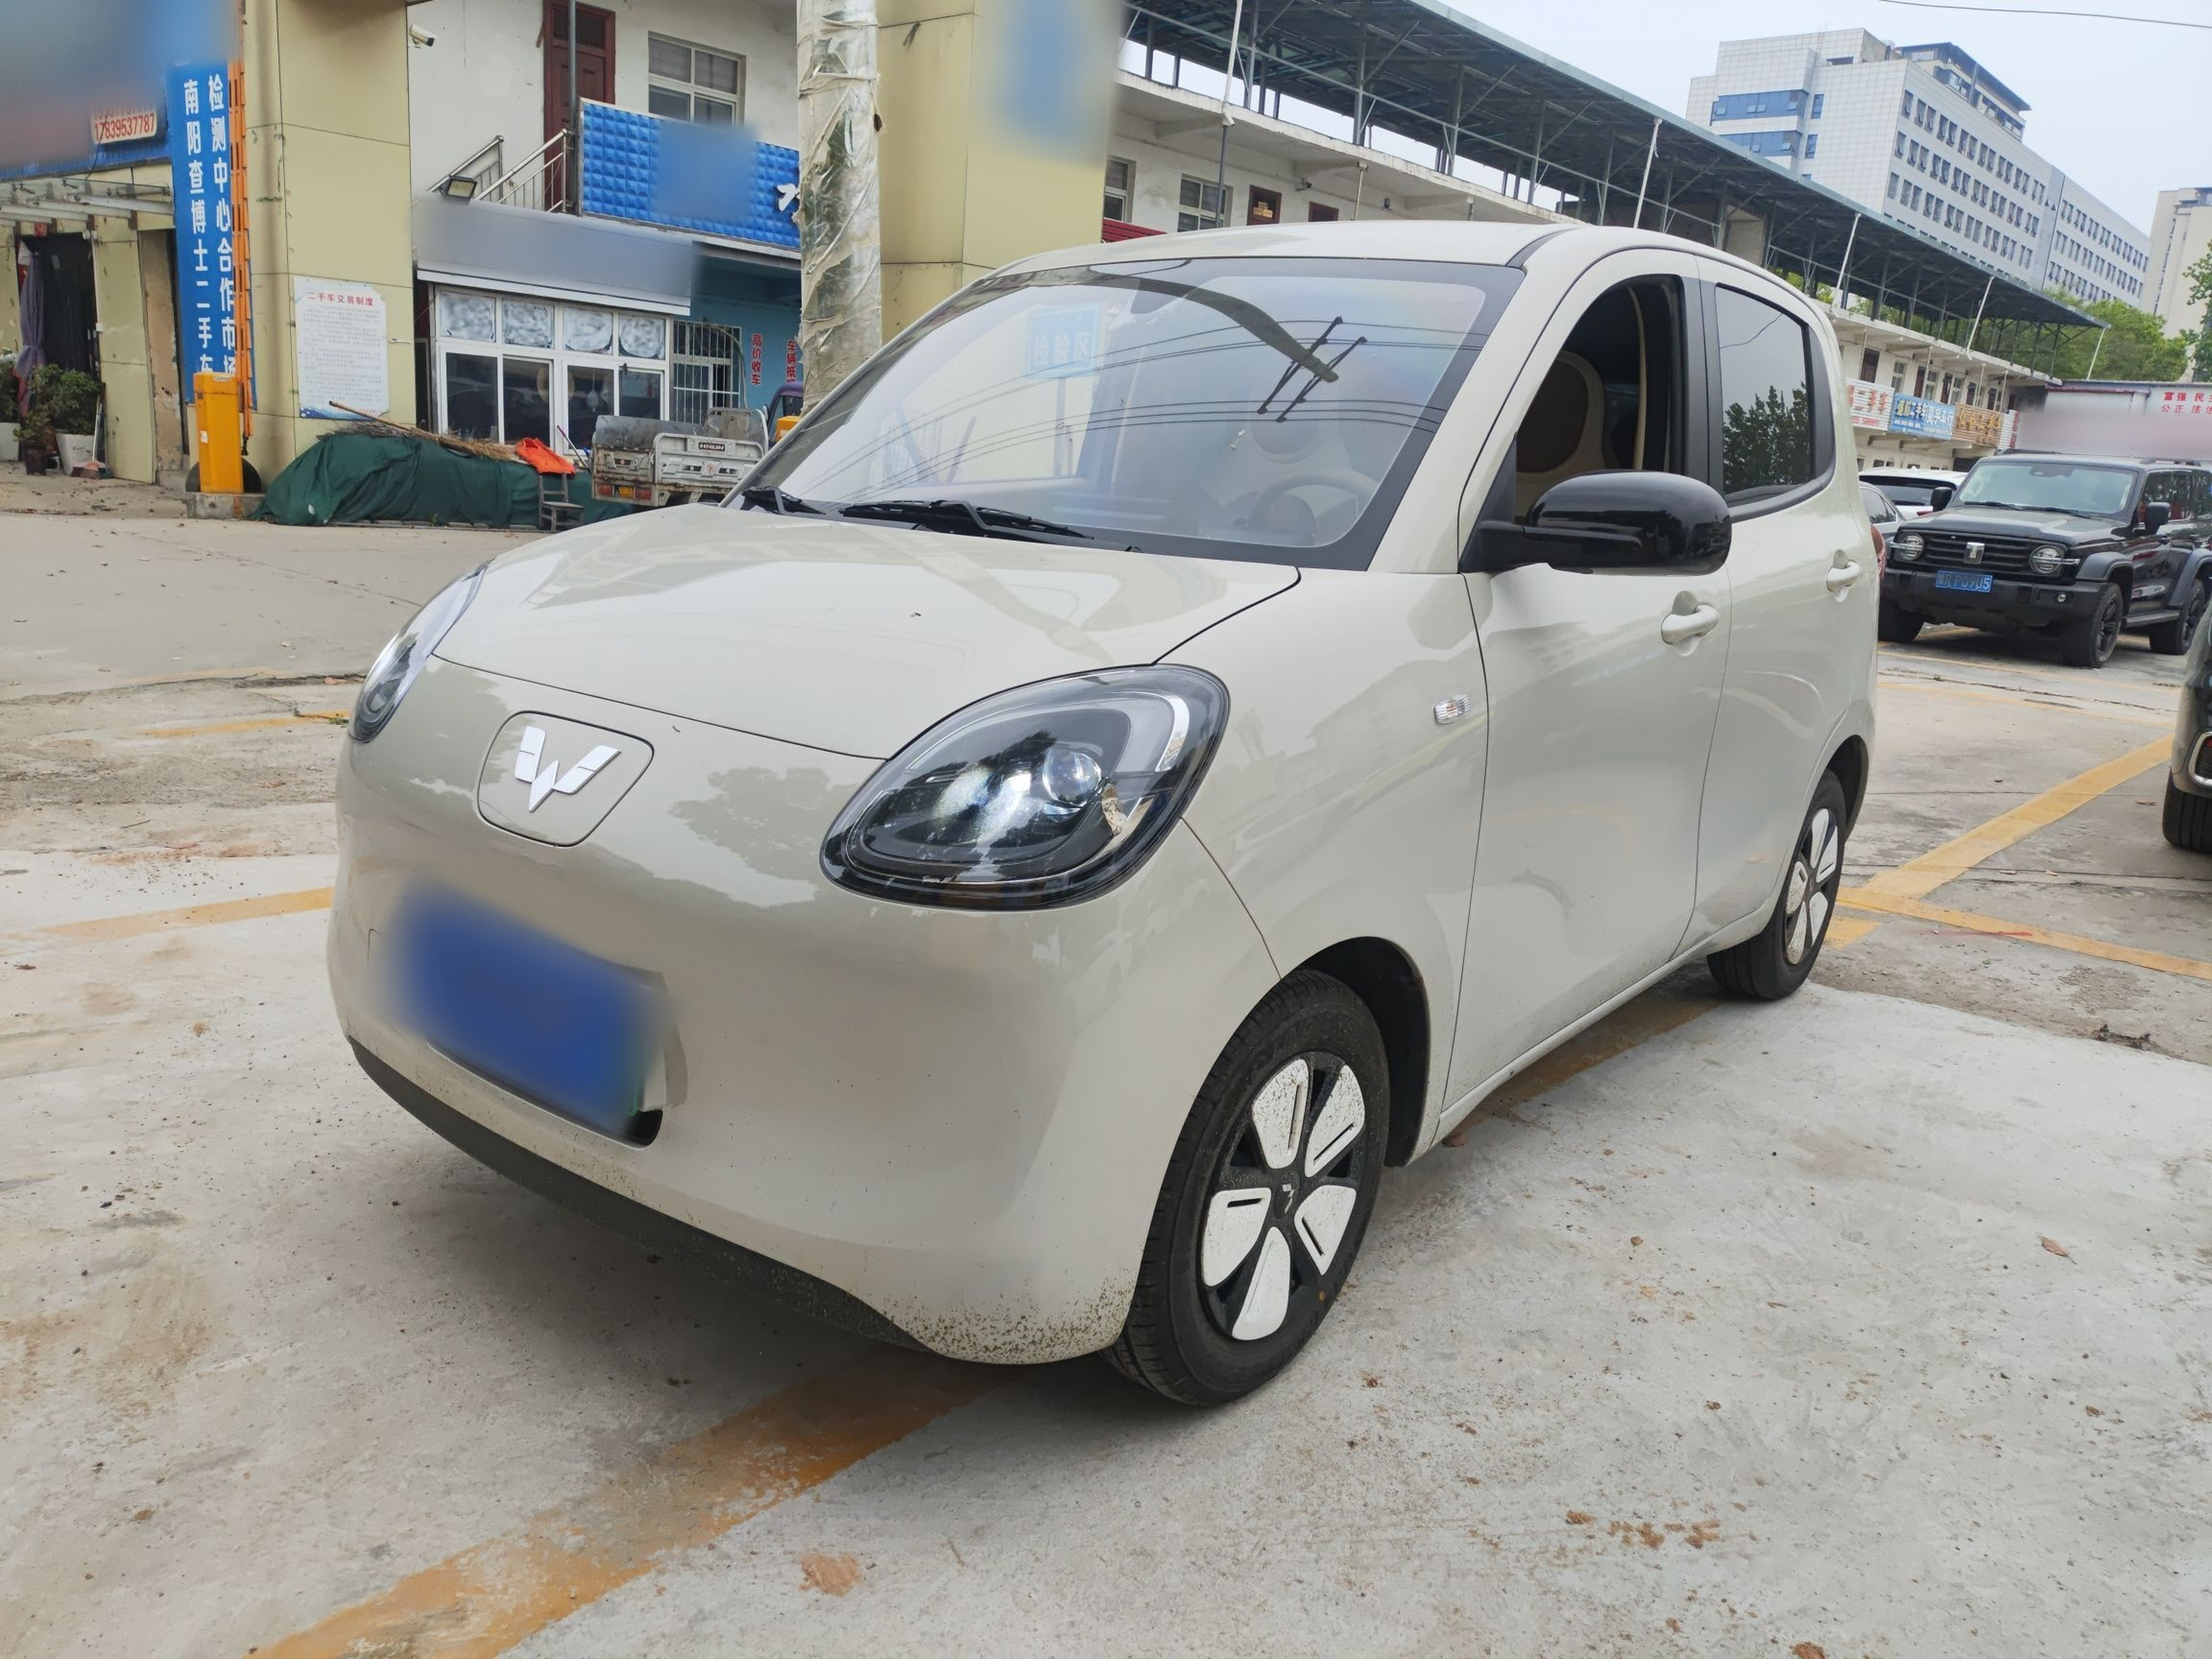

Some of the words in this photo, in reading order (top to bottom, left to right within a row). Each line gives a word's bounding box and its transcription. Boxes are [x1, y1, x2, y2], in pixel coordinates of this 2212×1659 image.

[94, 112, 154, 141] 17839537787
[307, 292, 374, 306] 二手车交易制度
[751, 333, 762, 386] 高价收车
[2164, 392, 2186, 401] 富强
[2161, 404, 2184, 413] 公正
